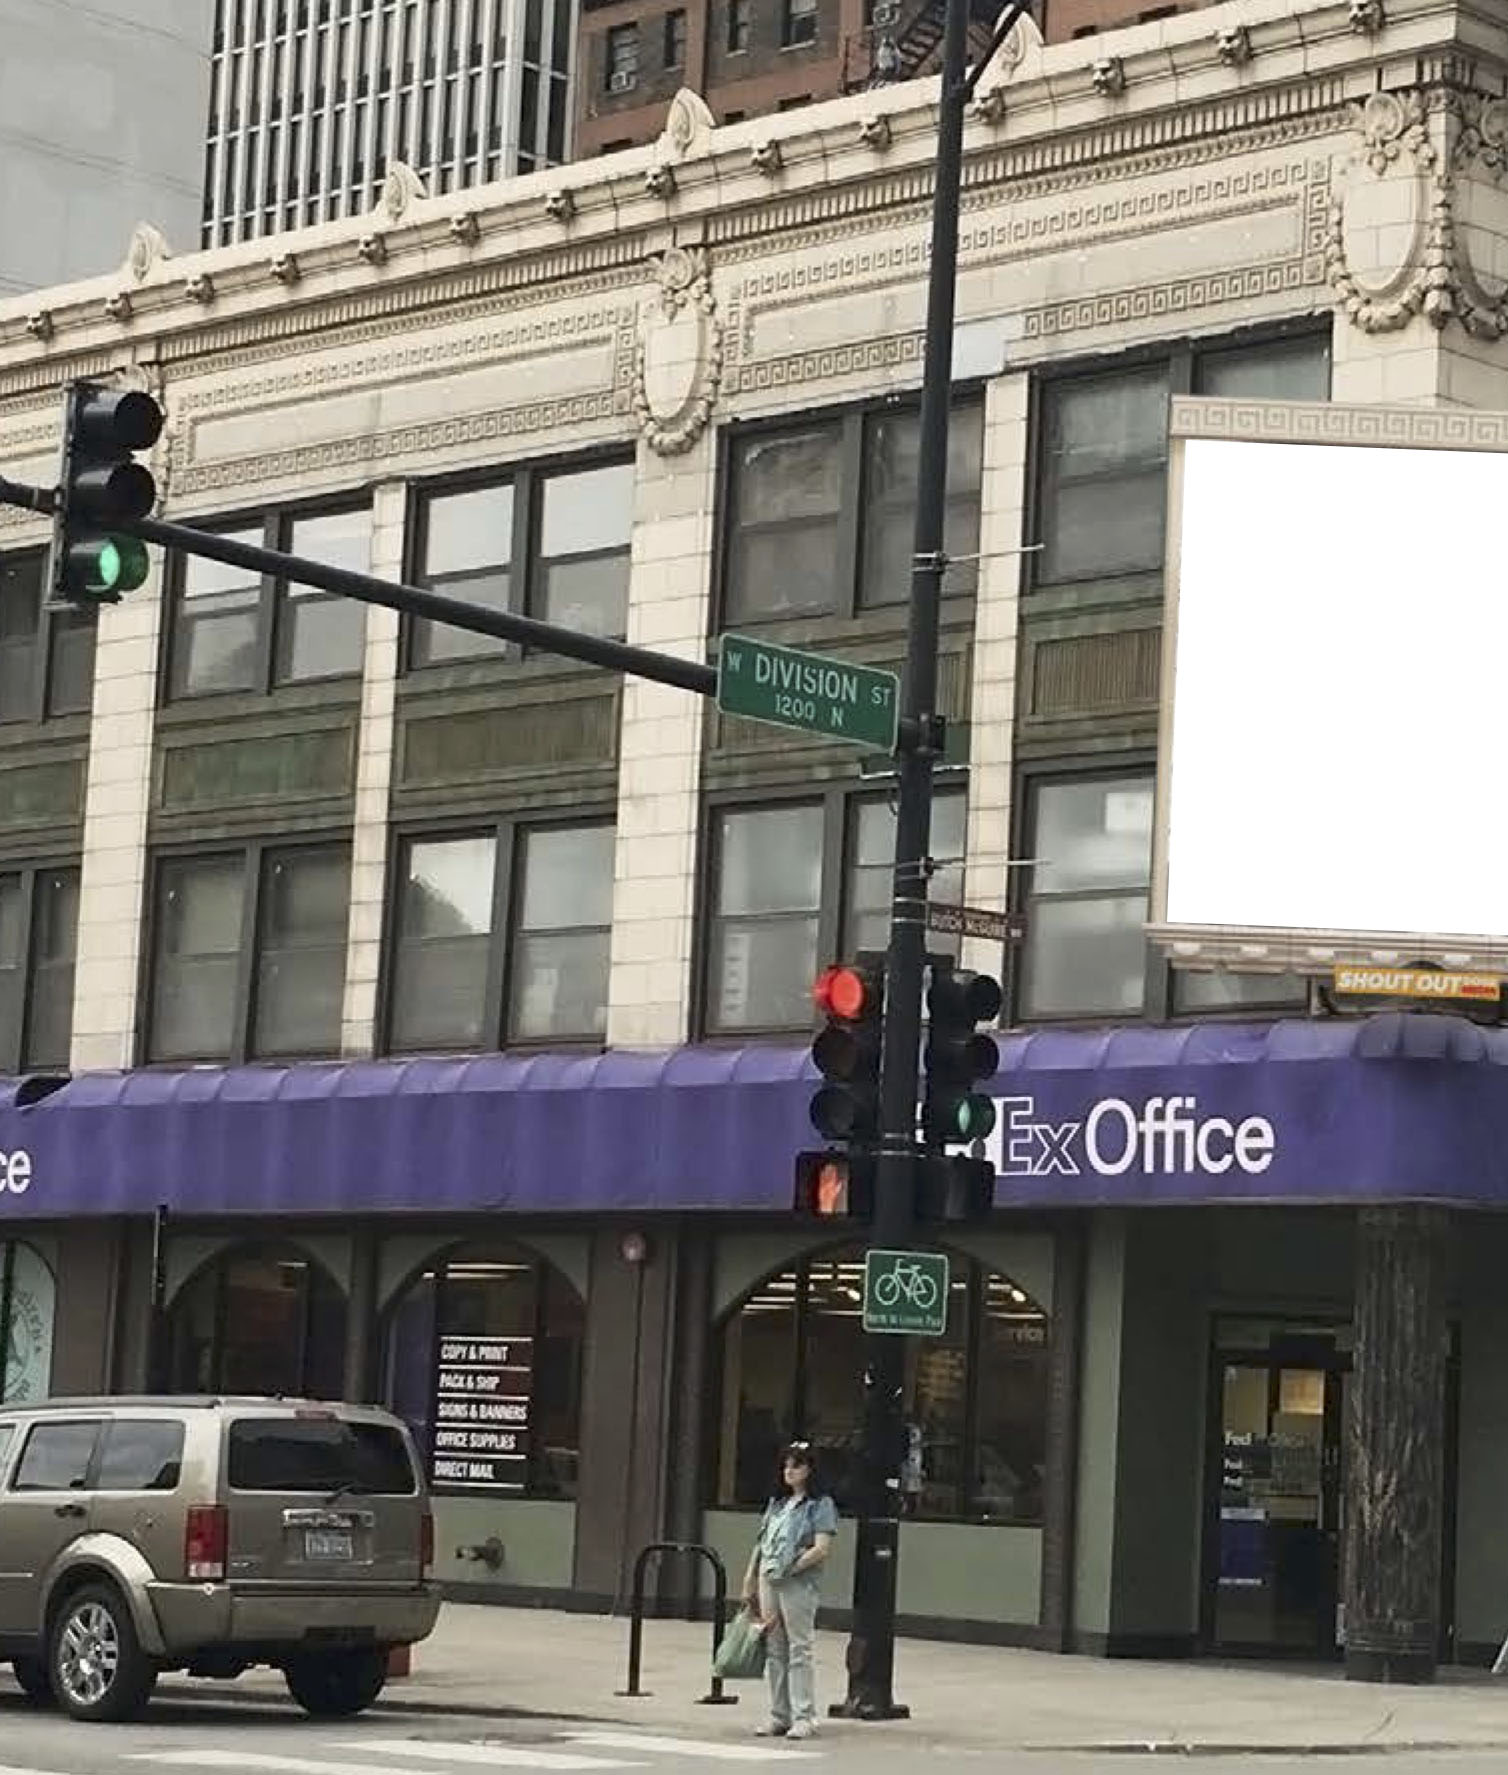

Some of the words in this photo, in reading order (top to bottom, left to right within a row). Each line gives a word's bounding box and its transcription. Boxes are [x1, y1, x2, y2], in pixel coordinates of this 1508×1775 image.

[727, 651, 742, 672] W
[755, 653, 858, 704] DIVISION
[871, 686, 891, 707] ST
[775, 694, 816, 720] 1200
[831, 706, 844, 727] N
[1338, 971, 1414, 990] SHOUT
[1415, 974, 1463, 995] OUT
[1085, 1096, 1275, 1176] Office
[441, 1344, 468, 1361] COPY
[479, 1346, 509, 1361] PRINT
[439, 1372, 466, 1388] PACK
[476, 1375, 500, 1391] SHIP
[438, 1402, 468, 1418] SIGNS
[479, 1404, 528, 1420] BANNERS
[436, 1432, 468, 1447] OFFICE
[469, 1432, 517, 1450] SUPPLIES
[434, 1460, 467, 1478] DIRECT
[469, 1462, 494, 1479] MAIL
